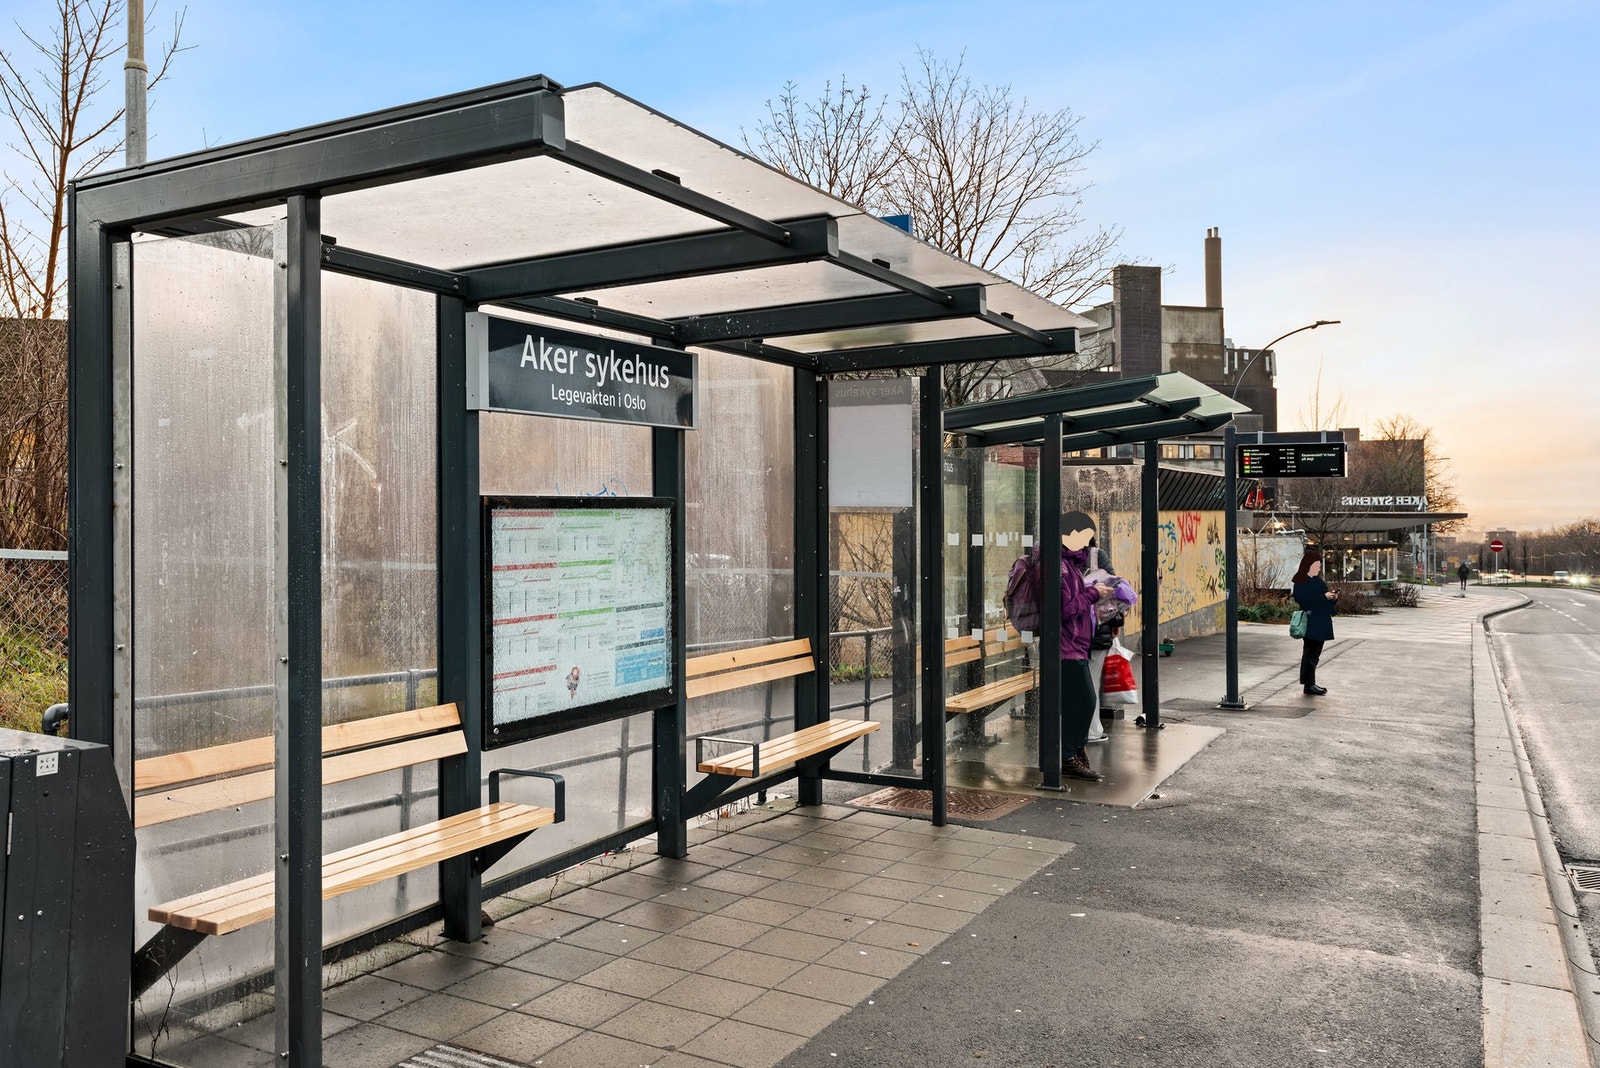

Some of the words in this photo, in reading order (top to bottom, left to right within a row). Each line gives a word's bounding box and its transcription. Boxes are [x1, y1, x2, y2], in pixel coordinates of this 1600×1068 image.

[520, 334, 579, 375] Aker
[585, 349, 670, 389] sykehus
[551, 383, 616, 407] Legevakten
[618, 395, 622, 408] i
[624, 393, 647, 411] Oslo
